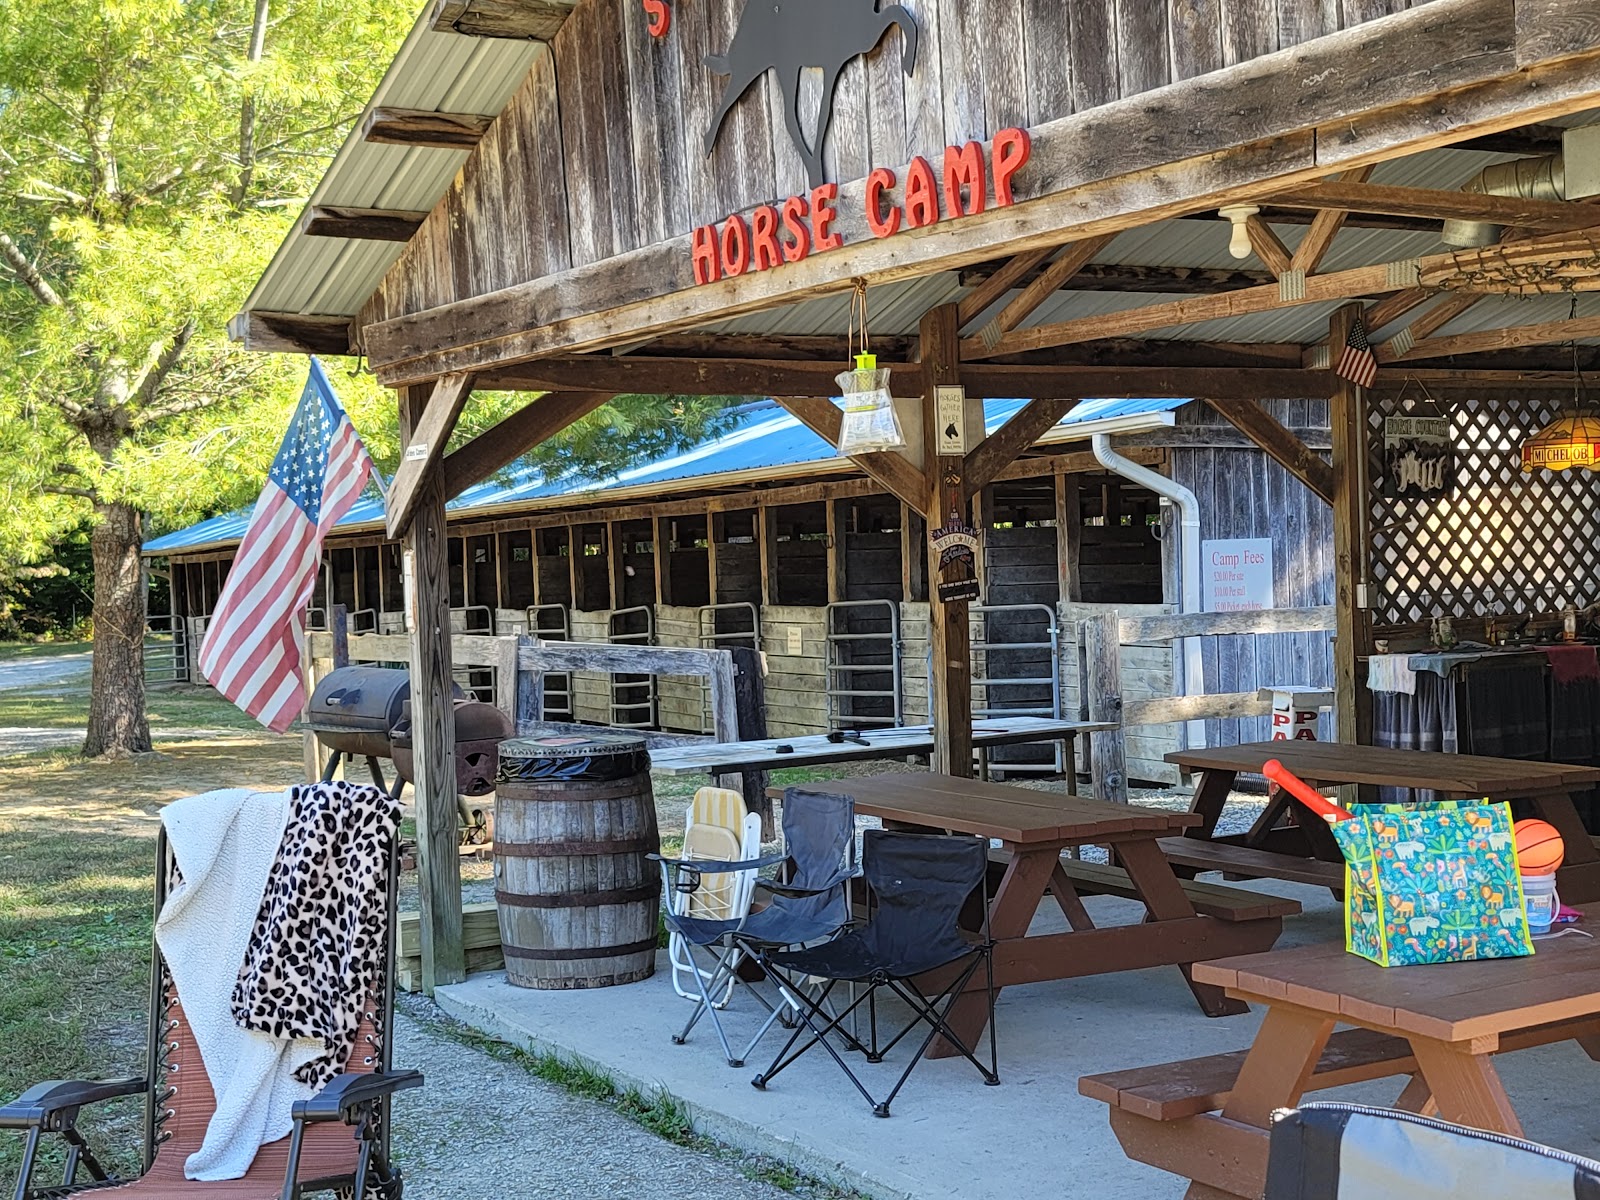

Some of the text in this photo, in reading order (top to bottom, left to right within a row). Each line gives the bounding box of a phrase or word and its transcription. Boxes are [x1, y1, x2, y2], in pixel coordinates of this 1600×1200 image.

[692, 127, 1031, 285] HORSE CAMP
[940, 394, 961, 402] HORSES
[940, 404, 961, 412] GATHER
[943, 414, 960, 422] HERE
[1534, 447, 1587, 462] MICHELOB
[935, 526, 974, 538] AMERICA
[935, 534, 977, 549] WELCOME
[1212, 549, 1265, 569] Camp Fees
